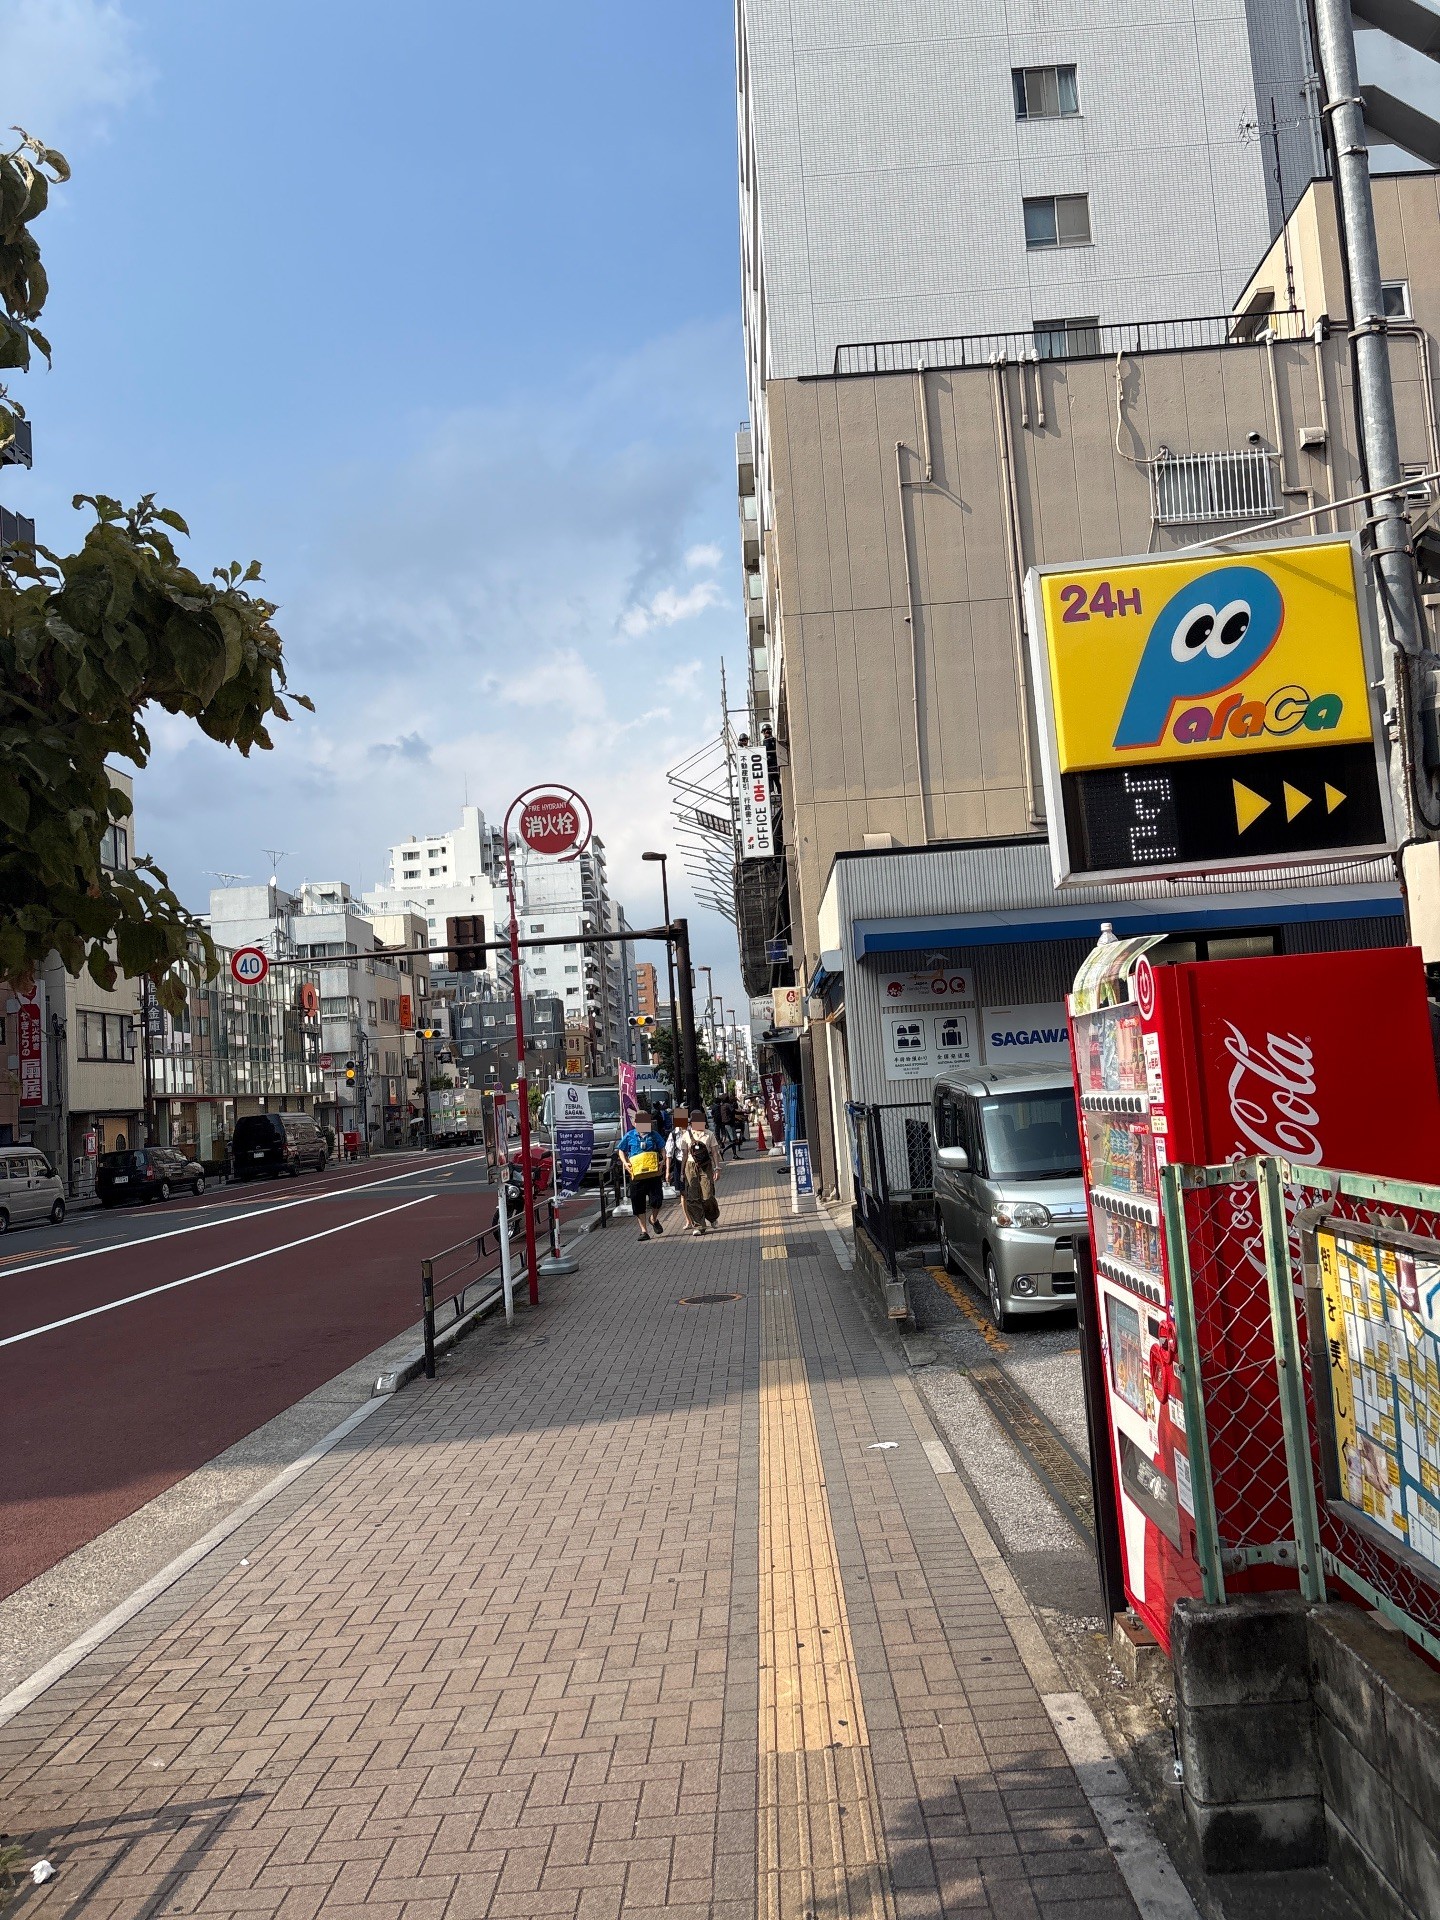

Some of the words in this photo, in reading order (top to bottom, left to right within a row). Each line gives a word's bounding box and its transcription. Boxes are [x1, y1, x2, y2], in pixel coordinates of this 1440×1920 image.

[1060, 582, 1142, 623] 24H
[751, 754, 765, 802] OH-EDO
[525, 812, 575, 838] 消火栓
[528, 804, 541, 812] FIRE
[541, 802, 568, 811] HYDRANT
[755, 807, 769, 849] OFFICE
[240, 958, 259, 974] 40
[21, 1011, 31, 1056] やきとりの
[991, 1028, 1070, 1047] SAGAWA
[794, 1148, 807, 1185] 佐川急便
